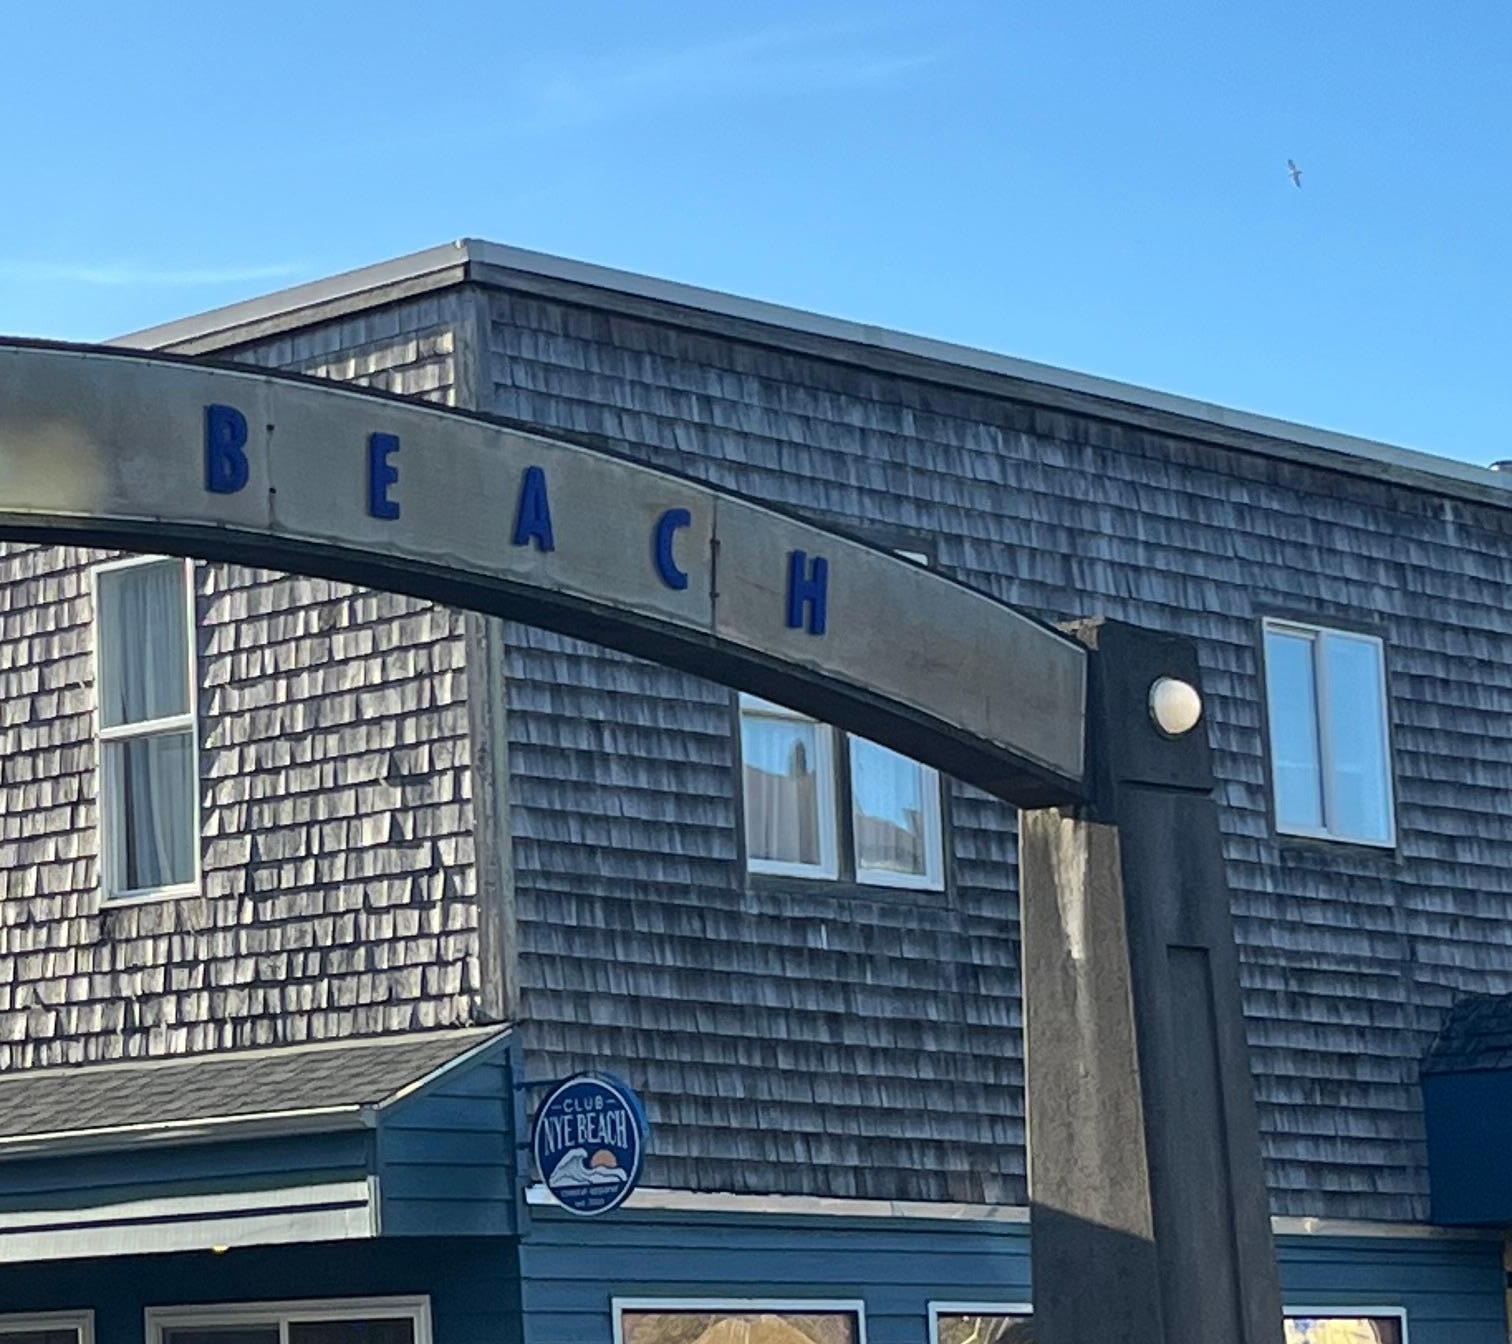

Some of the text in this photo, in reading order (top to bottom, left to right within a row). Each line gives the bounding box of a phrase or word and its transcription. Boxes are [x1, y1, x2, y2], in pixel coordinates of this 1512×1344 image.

[203, 403, 829, 635] BEACH
[562, 1095, 604, 1113] CLUB
[543, 1110, 628, 1156] NYE BEACH
